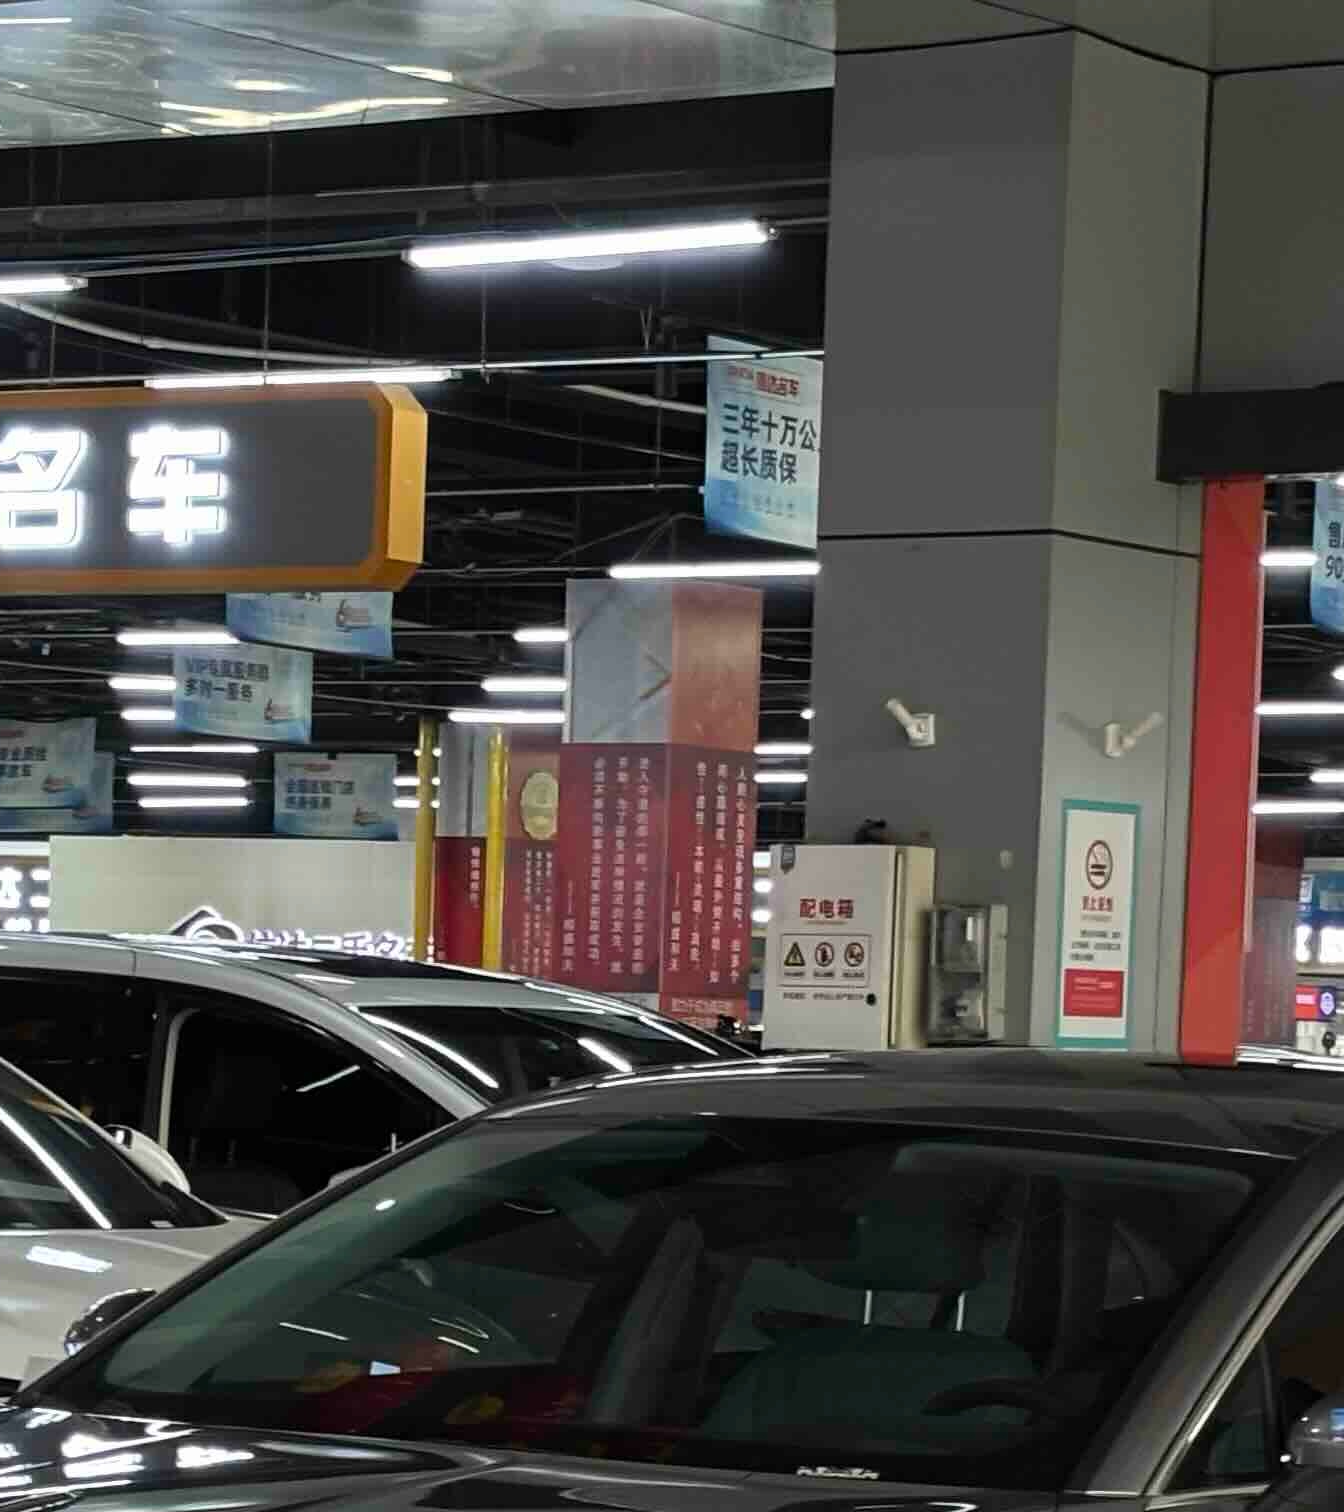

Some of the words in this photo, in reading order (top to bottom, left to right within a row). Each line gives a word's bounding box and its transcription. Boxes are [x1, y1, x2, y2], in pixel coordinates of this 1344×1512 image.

[722, 402, 818, 452] 三年十万公
[722, 441, 798, 484] 超长质保
